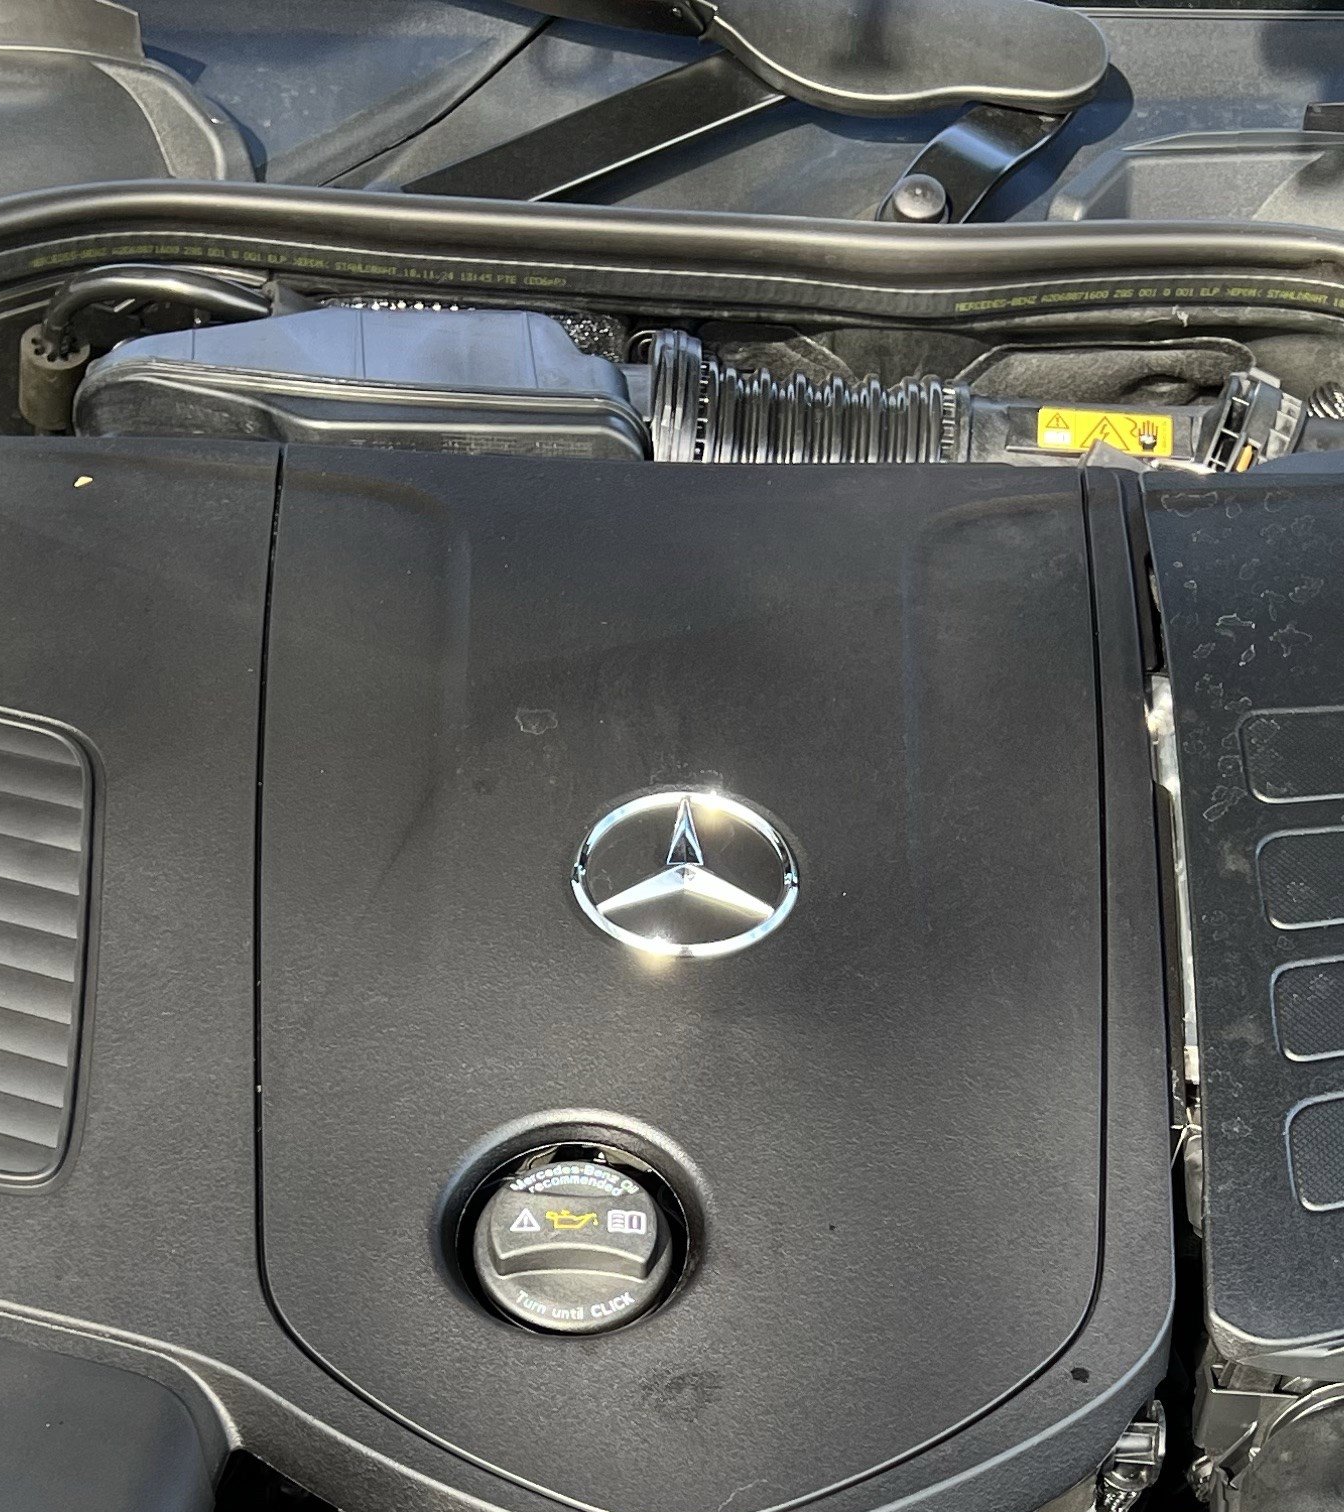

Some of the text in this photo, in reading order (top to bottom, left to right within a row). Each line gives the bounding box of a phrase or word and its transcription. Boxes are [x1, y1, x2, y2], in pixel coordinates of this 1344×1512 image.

[509, 1164, 640, 1195] Mercedes-Benz Oil
[528, 1175, 624, 1196] recommended
[516, 1289, 636, 1320] Turn until CLICK
